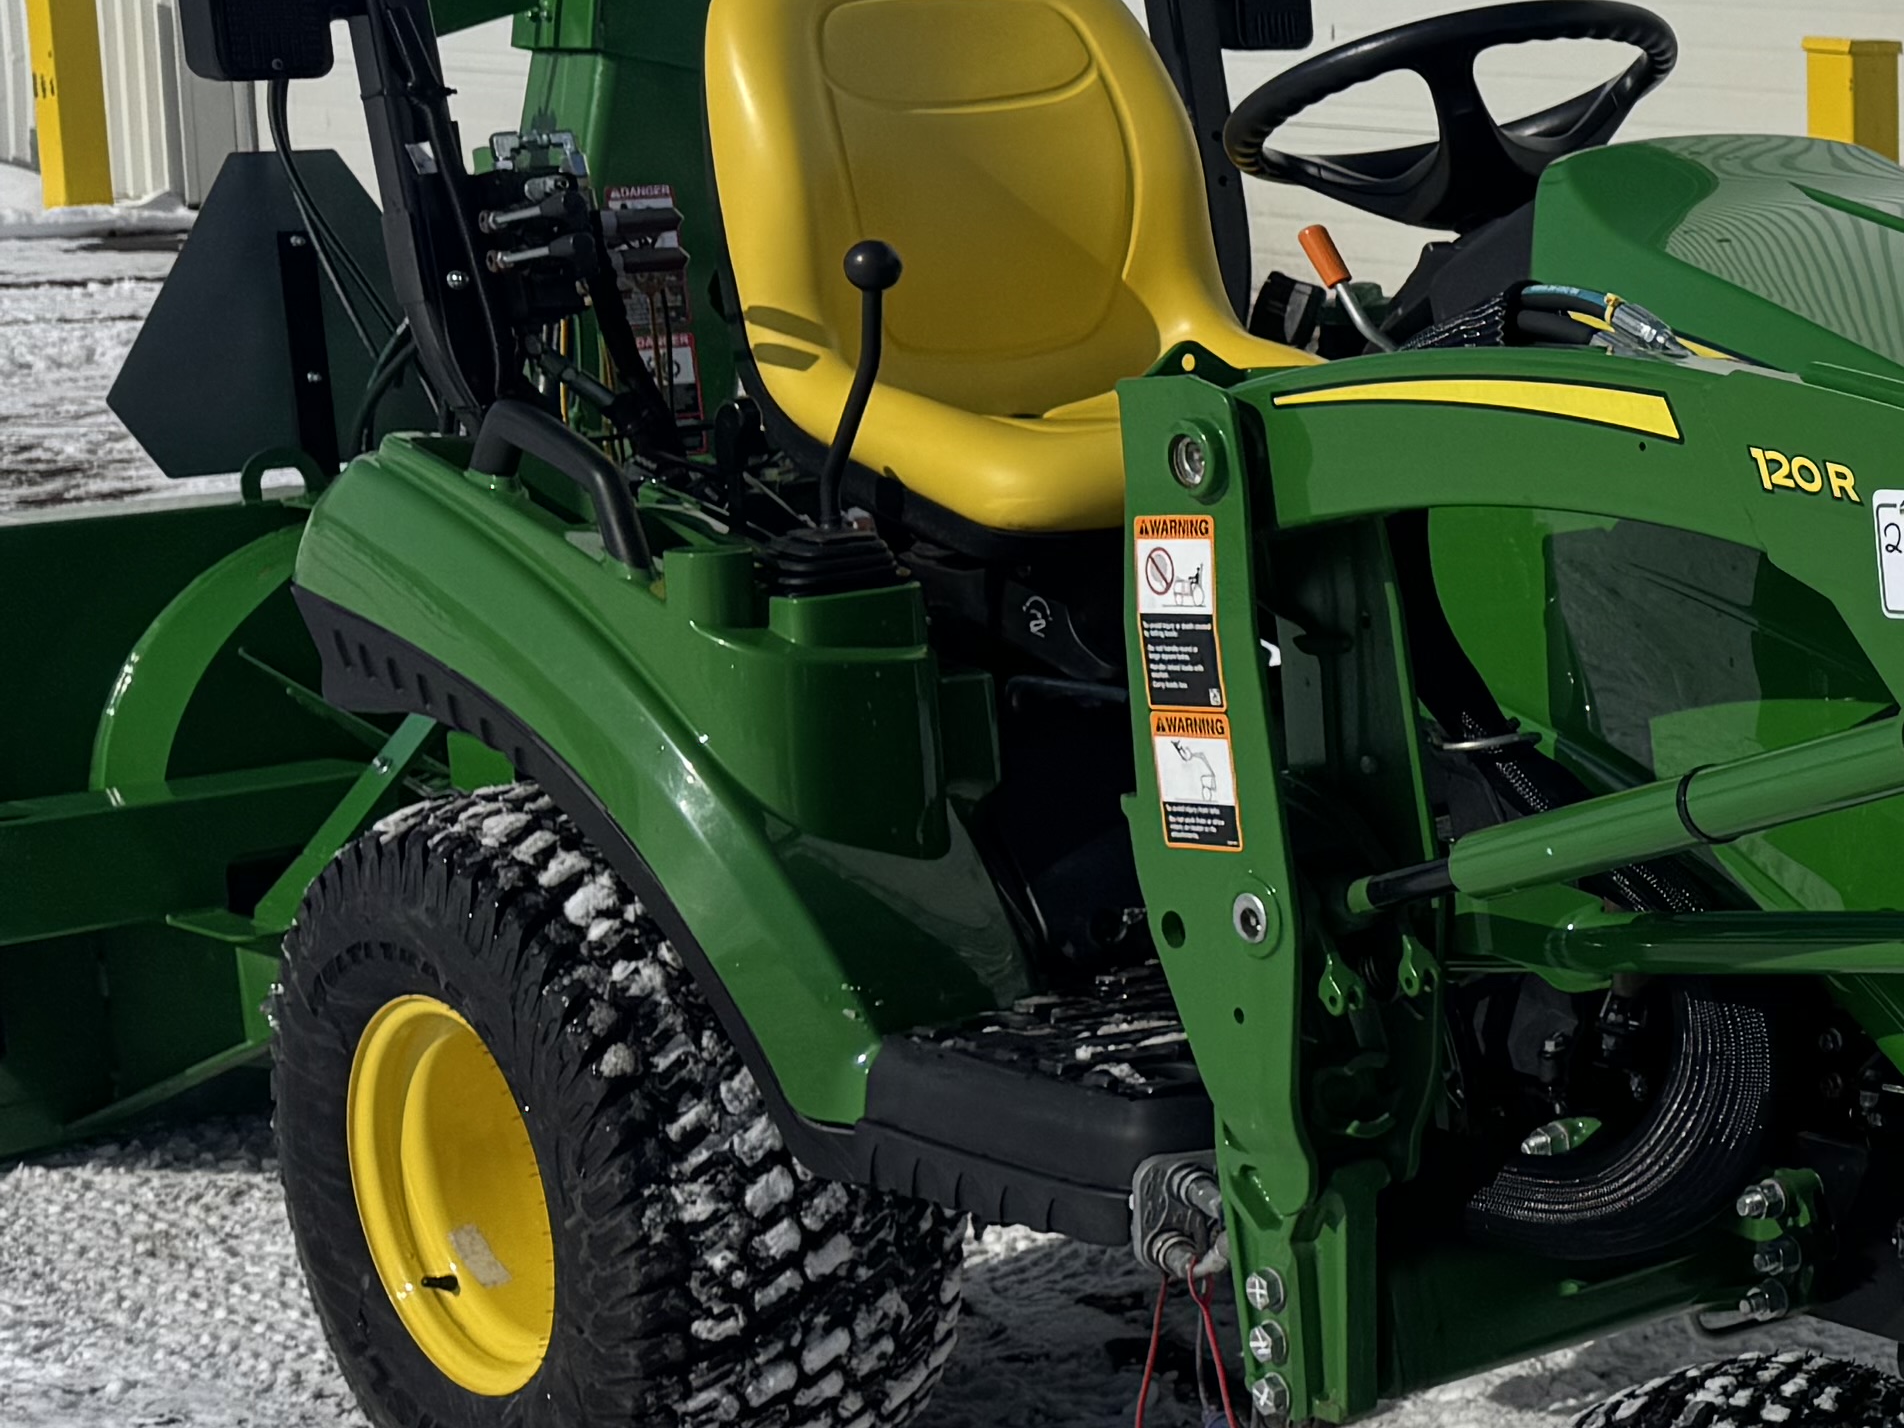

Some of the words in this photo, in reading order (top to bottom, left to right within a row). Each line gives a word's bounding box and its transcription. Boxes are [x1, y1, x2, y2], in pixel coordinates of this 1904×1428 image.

[620, 184, 670, 198] DANGER
[636, 334, 689, 349] DANER
[1149, 519, 1209, 536] WARNING
[1165, 717, 1225, 735] WARNING
